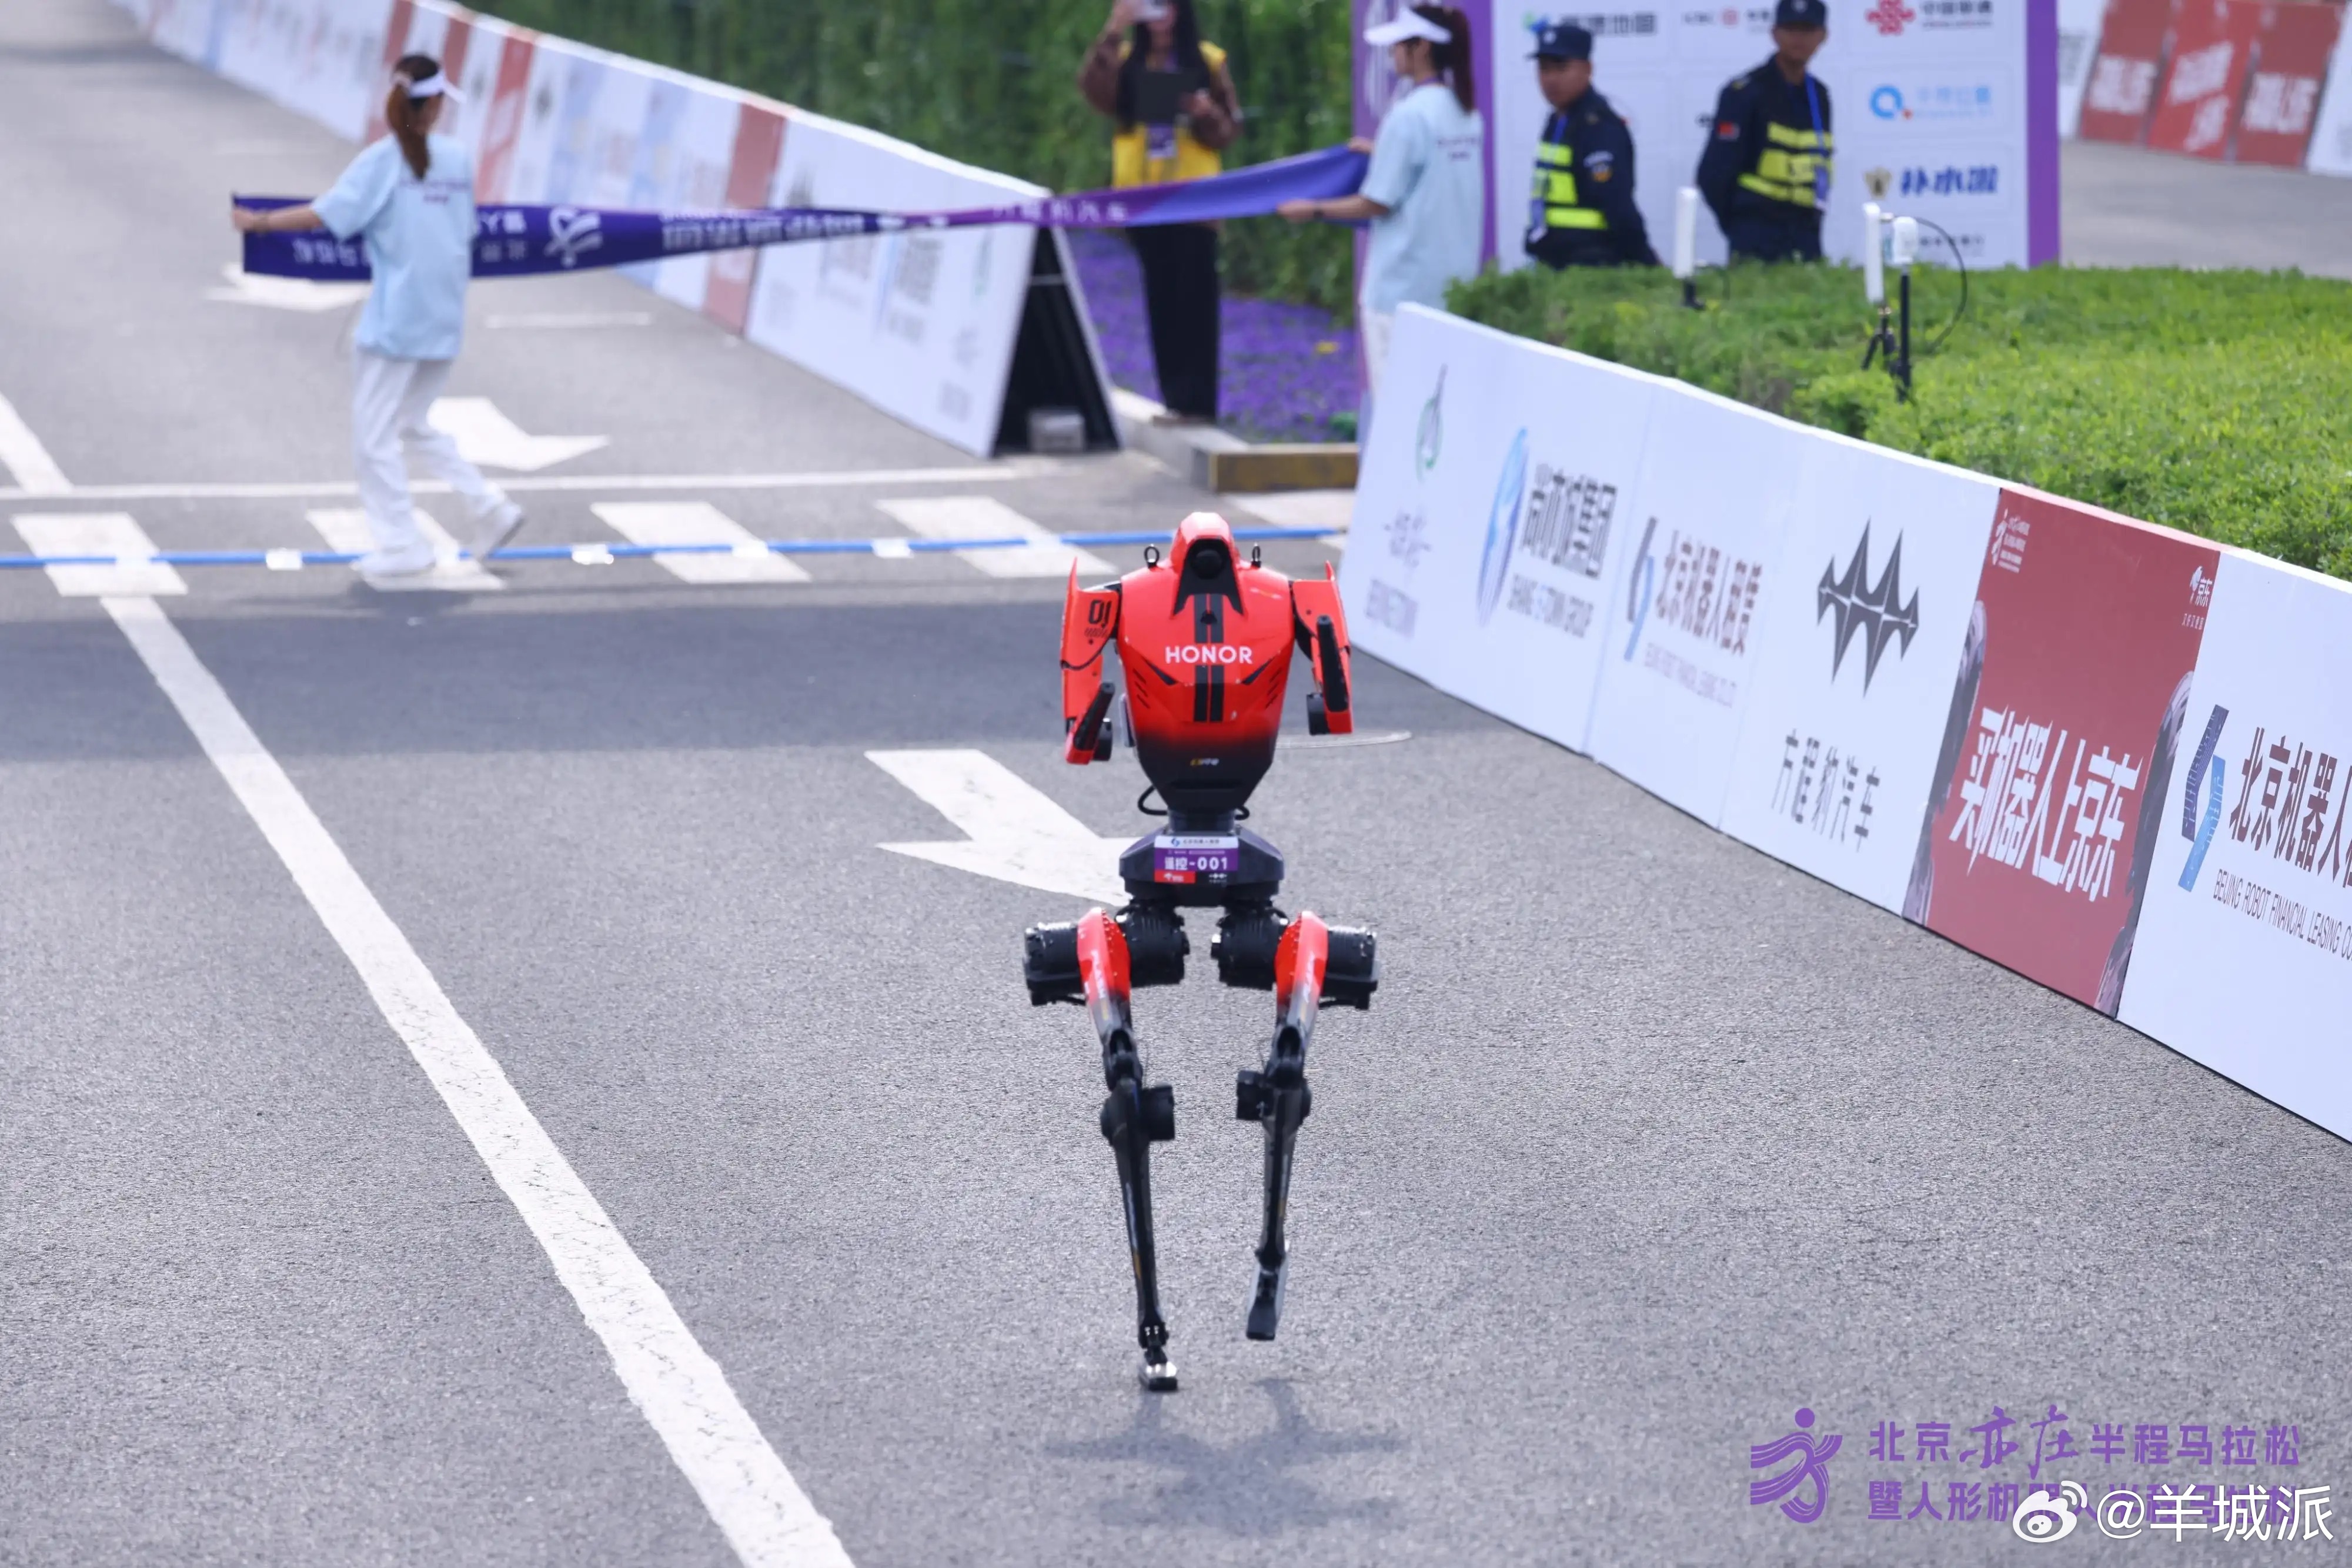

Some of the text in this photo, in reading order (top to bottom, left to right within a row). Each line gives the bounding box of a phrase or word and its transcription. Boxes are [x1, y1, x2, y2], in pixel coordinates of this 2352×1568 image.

[1088, 600, 1112, 624] 01
[2195, 576, 2213, 607] 京东
[1165, 646, 1252, 664] HONOR
[1771, 728, 1880, 852] 方程豹汽车
[1949, 704, 2144, 902] 买机器人上京东
[2213, 868, 2243, 910] BEIJING
[2241, 882, 2271, 920] ROBOT
[2269, 894, 2307, 939] FINANCIAL
[2307, 911, 2342, 954] LEASING
